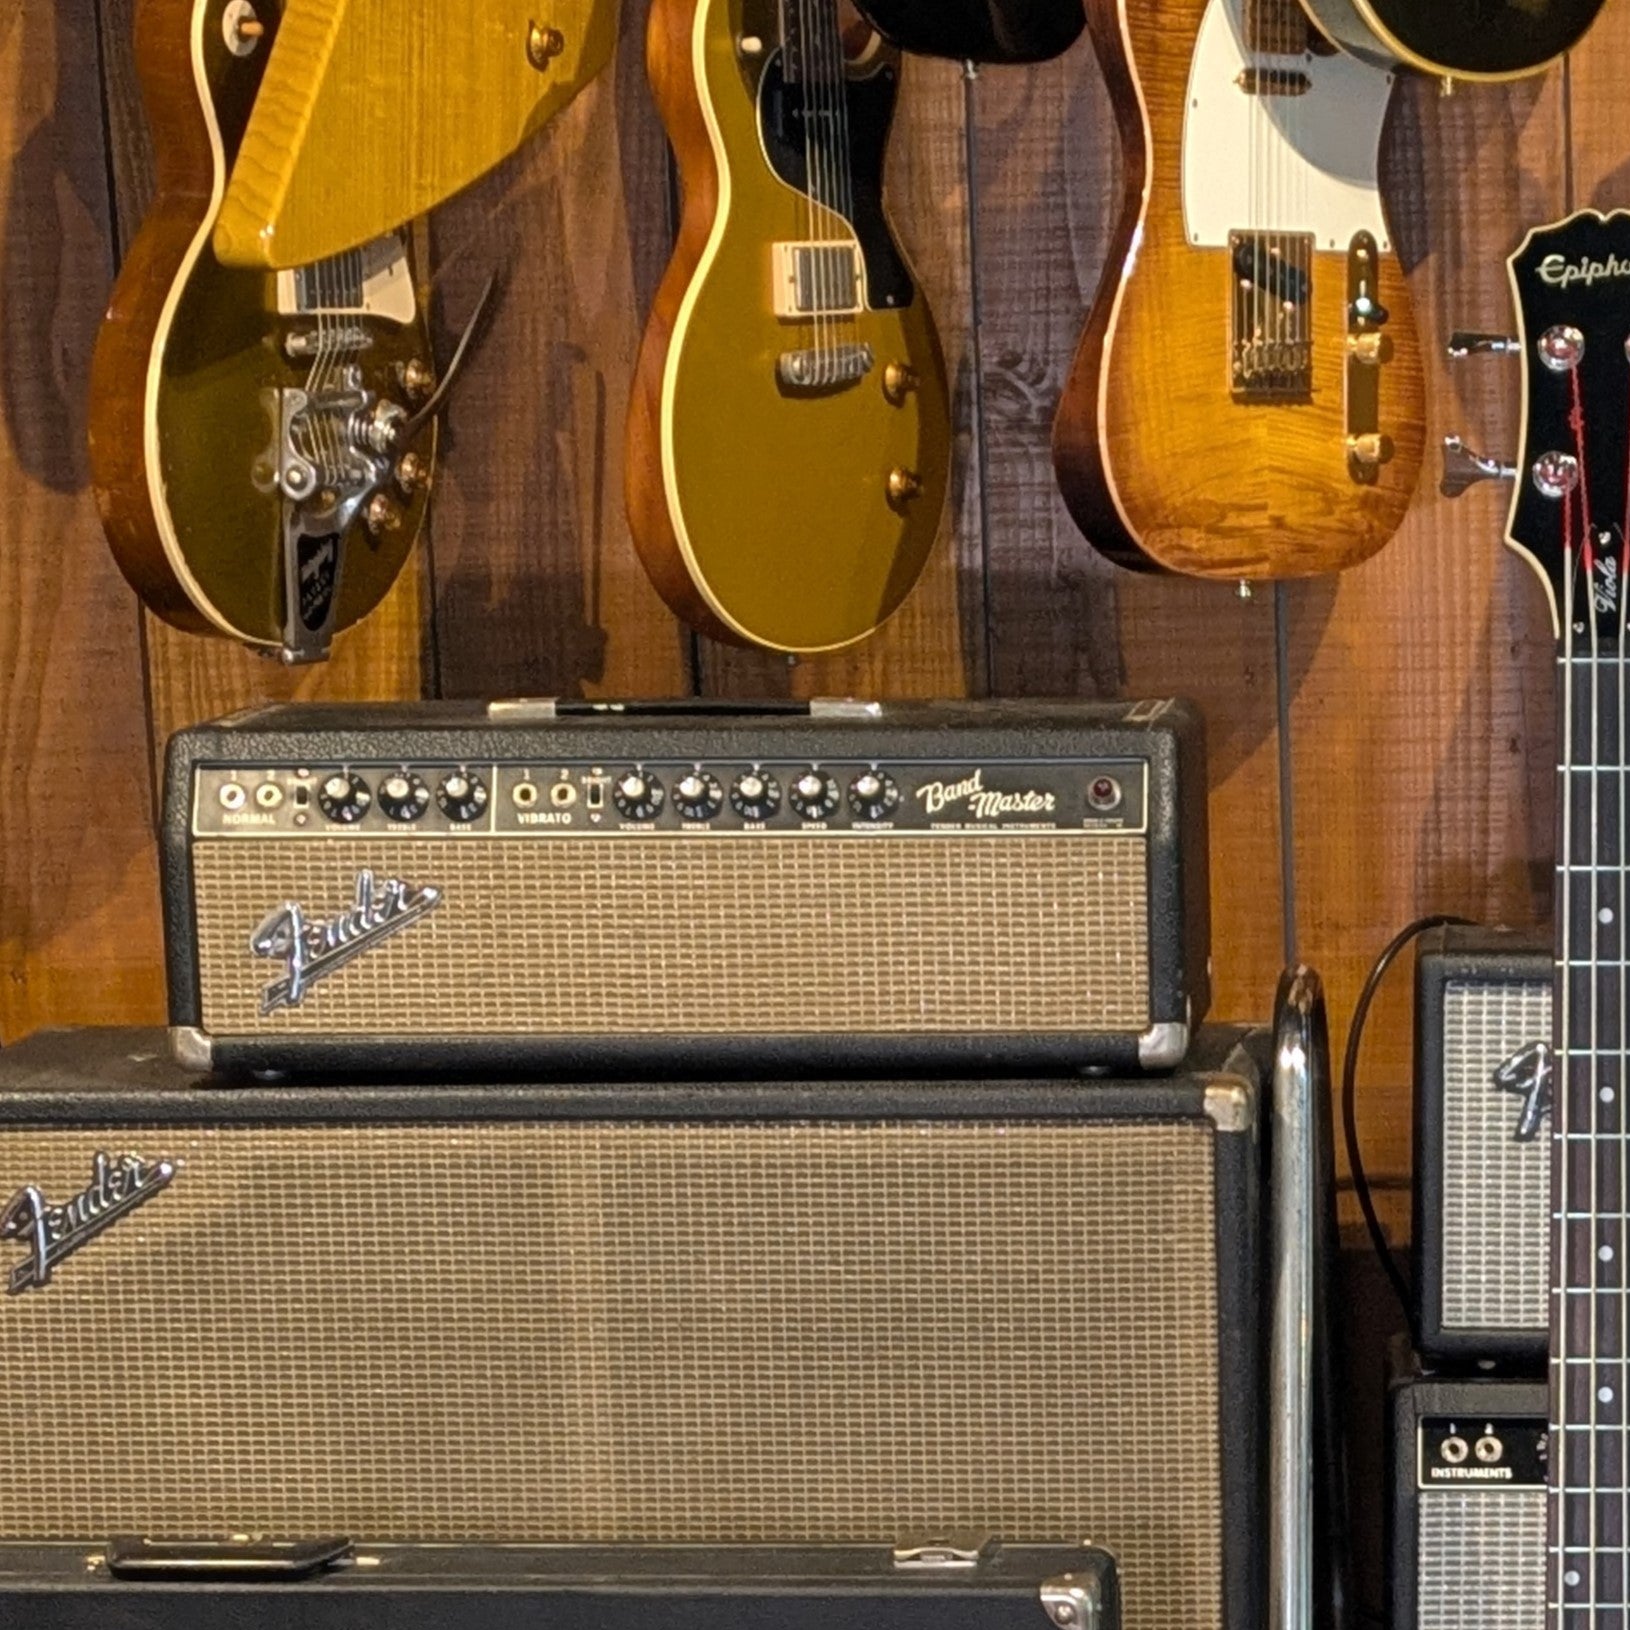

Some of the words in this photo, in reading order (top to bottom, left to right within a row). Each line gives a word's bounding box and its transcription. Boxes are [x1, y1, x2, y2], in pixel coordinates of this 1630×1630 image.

[1594, 556, 1617, 613] Viola
[522, 769, 530, 781] 1
[560, 768, 569, 781] 2
[916, 768, 984, 814] Band
[222, 813, 276, 825] NORMAL
[517, 812, 572, 825] VIBRATO
[251, 869, 443, 1015] Fender
[0, 1151, 175, 1295] Fender
[1431, 1467, 1513, 1479] INSTRUMENTS
